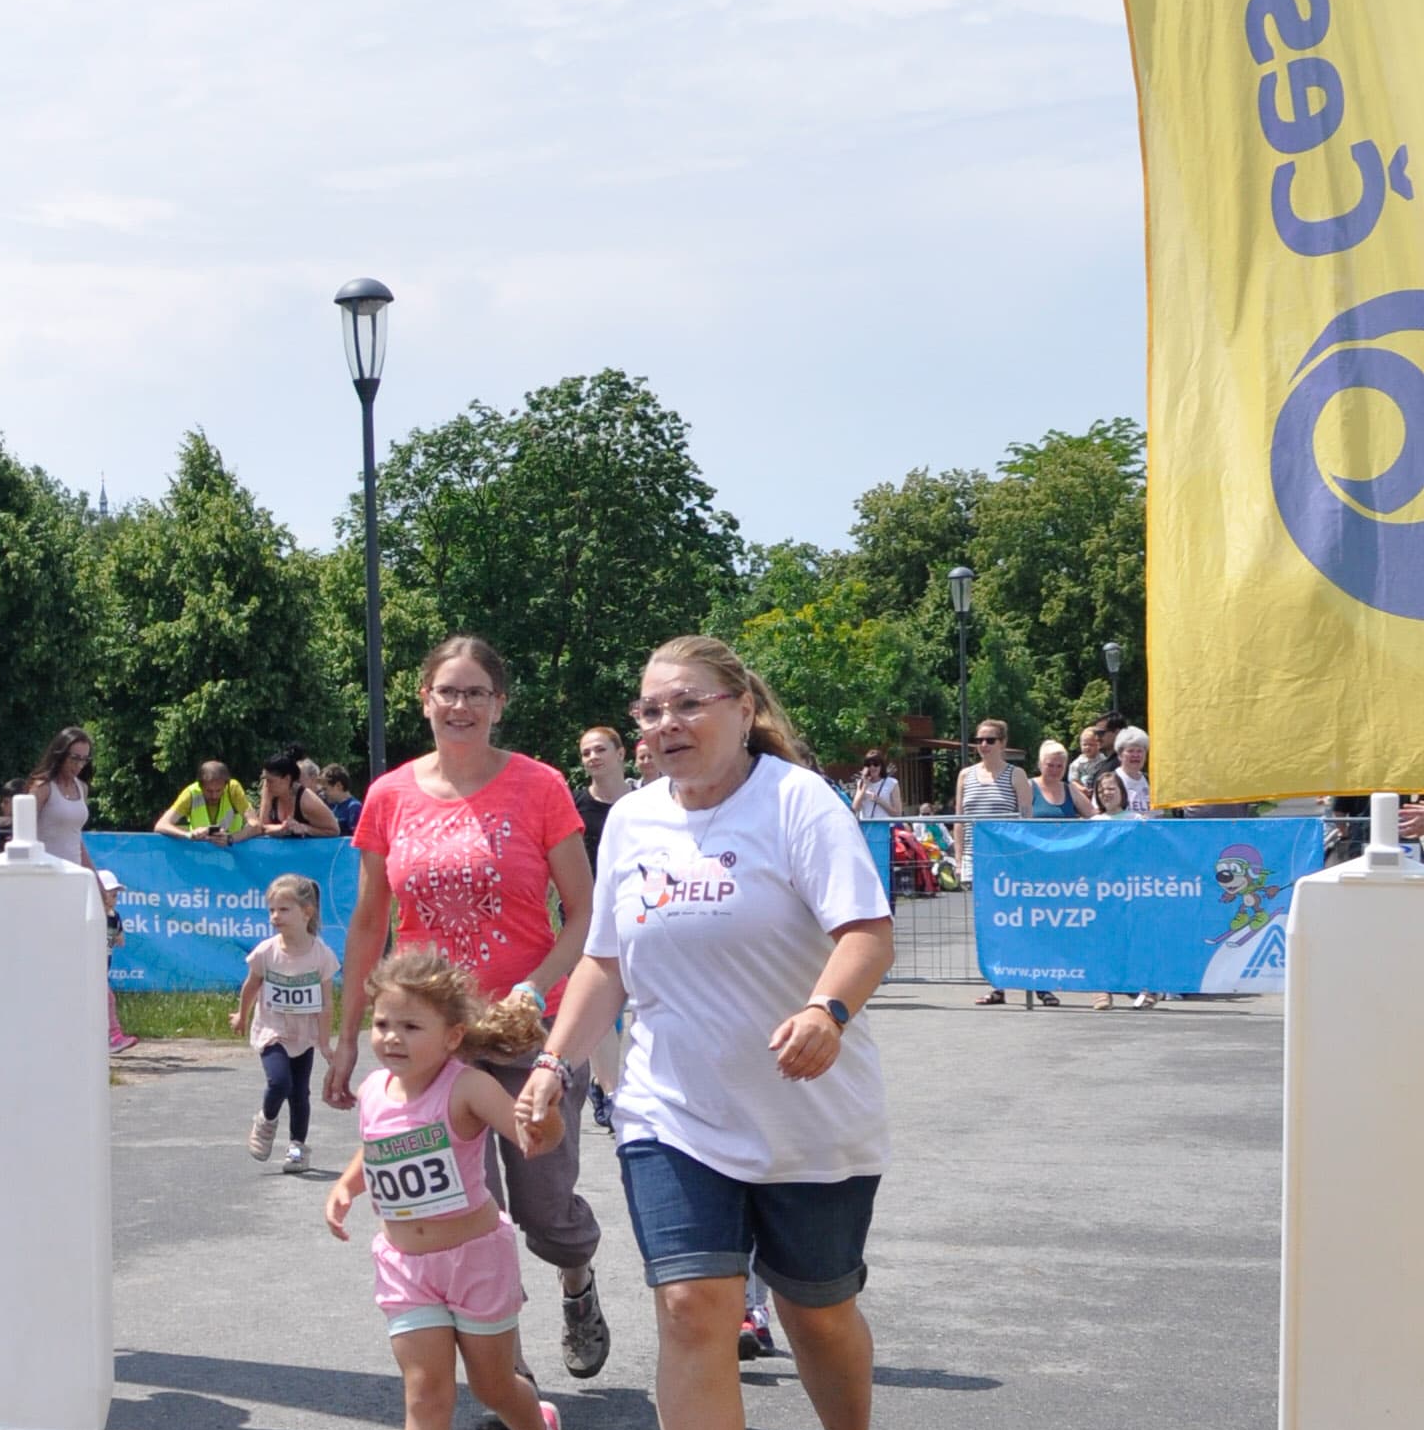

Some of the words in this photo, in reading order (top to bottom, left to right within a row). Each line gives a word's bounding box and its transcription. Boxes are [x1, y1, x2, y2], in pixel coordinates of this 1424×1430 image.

[671, 880, 735, 903] HELP
[993, 872, 1090, 897] Úrazové
[1096, 875, 1202, 901] pojištění
[166, 887, 210, 909] vaši
[154, 914, 161, 934] i
[993, 906, 1023, 928] od
[1031, 908, 1097, 928] PVZP
[271, 985, 313, 1005] 2101
[391, 1127, 444, 1156] HELP
[365, 1157, 451, 1202] 2003
